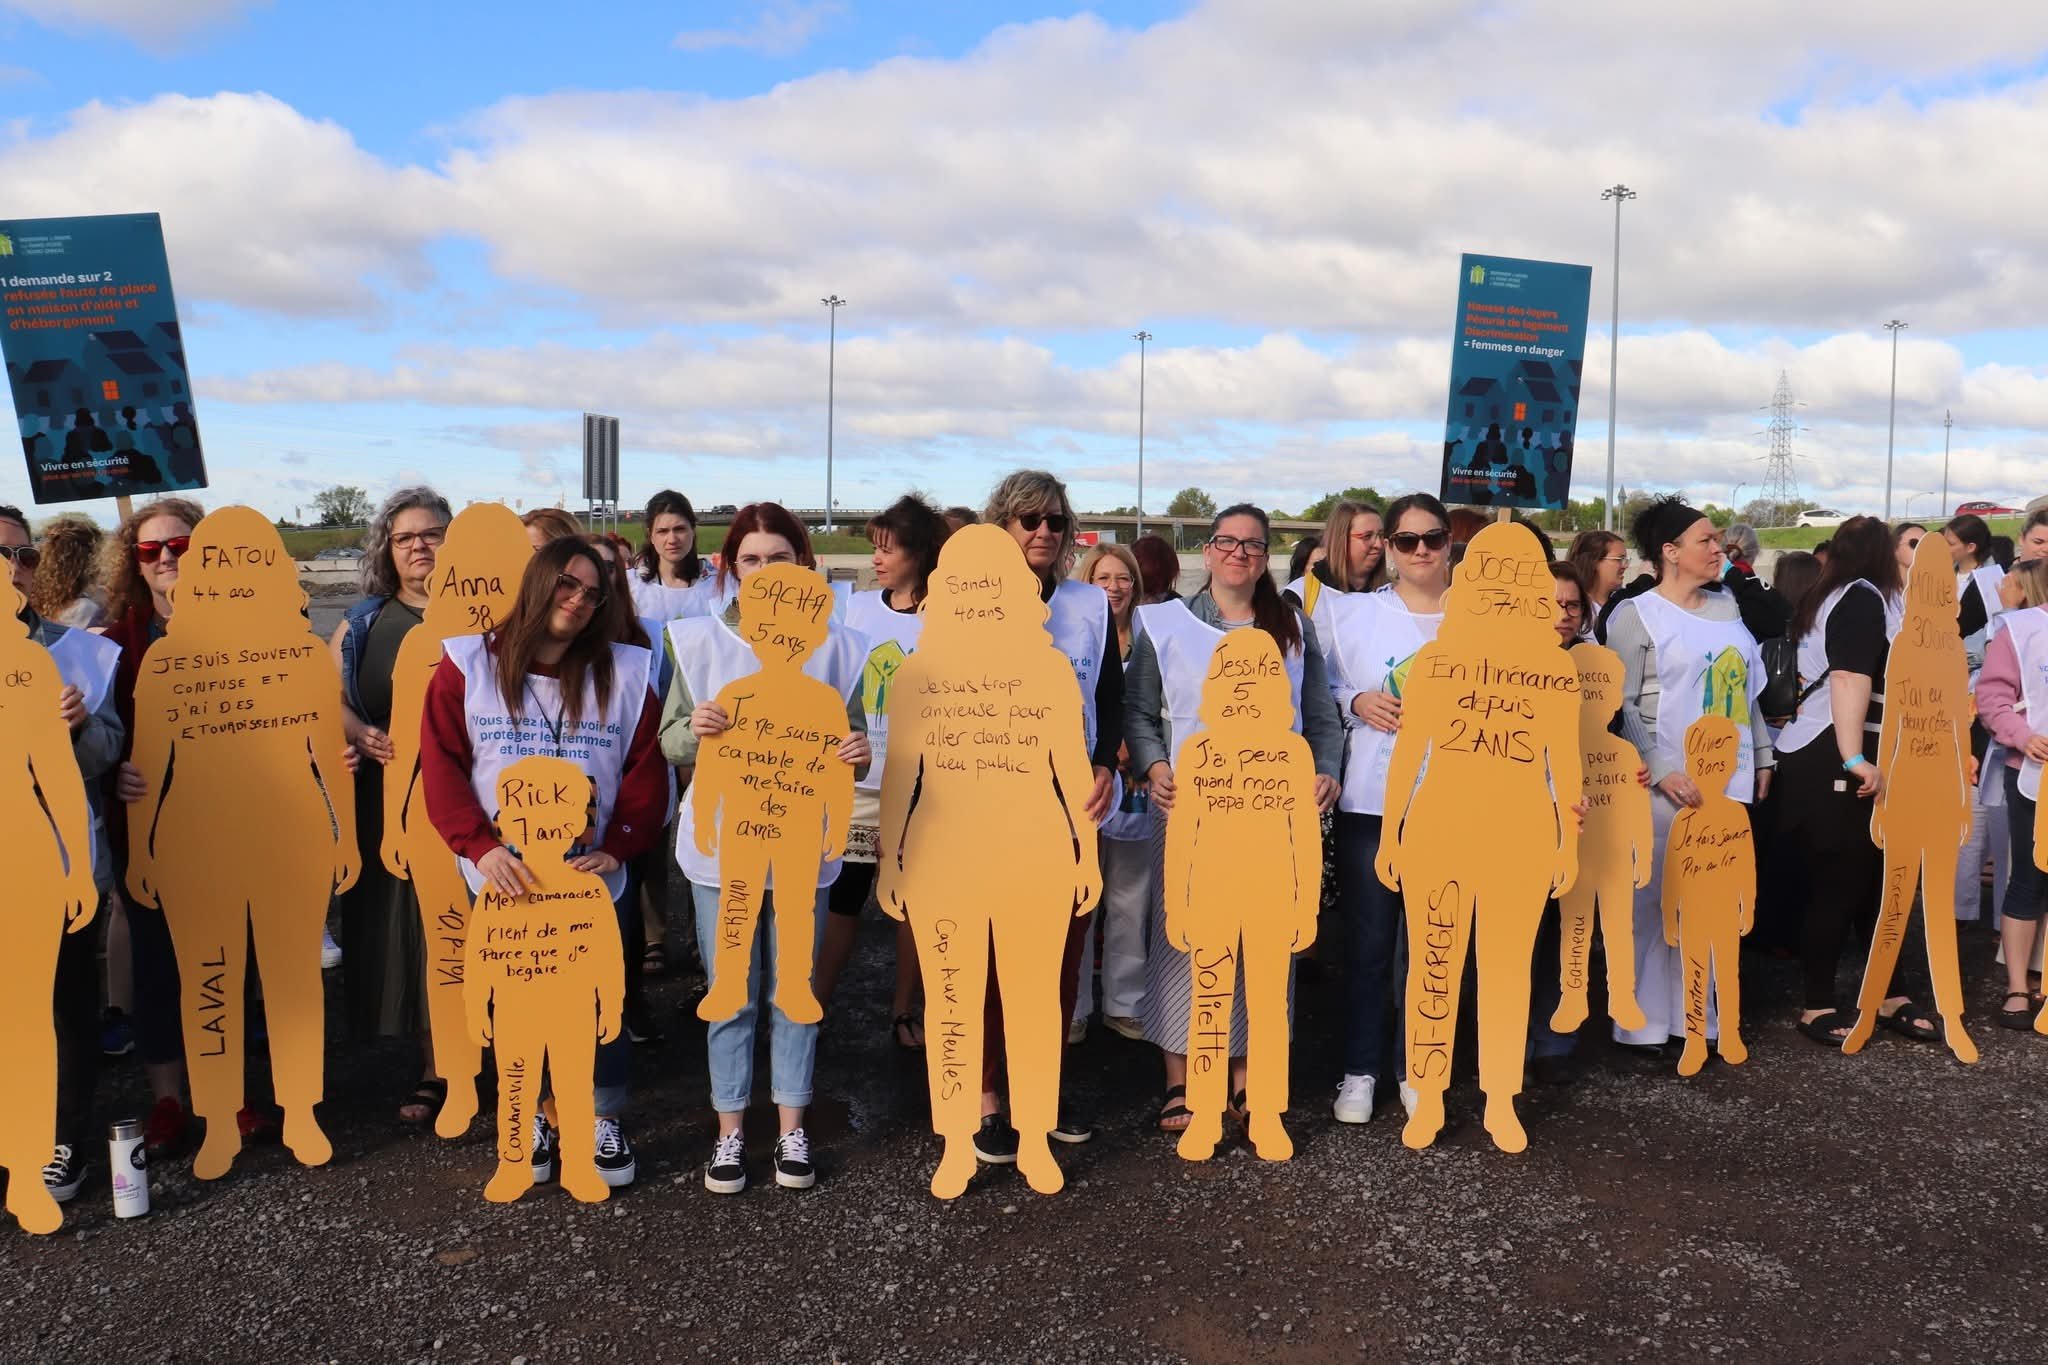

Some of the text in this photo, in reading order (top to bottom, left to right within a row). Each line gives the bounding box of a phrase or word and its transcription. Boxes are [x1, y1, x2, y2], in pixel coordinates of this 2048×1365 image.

[9, 273, 76, 287] demande
[78, 273, 101, 283] sur
[104, 272, 112, 281] 2
[60, 287, 96, 297] faute
[100, 286, 116, 296] de
[121, 283, 157, 296] place
[7, 299, 139, 316] en maison d'aide et
[1507, 306, 1524, 316] des
[1508, 318, 1520, 328] de
[1471, 339, 1513, 352] femmes
[1514, 345, 1527, 353] en
[1529, 345, 1564, 358] danger
[40, 463, 69, 471] Vivre
[86, 456, 129, 468] sécurité
[1452, 467, 1472, 476] Vivre
[1485, 468, 1517, 479] sécurité
[201, 545, 276, 569] FATOU
[194, 586, 220, 599] 44
[439, 566, 504, 597] Anna
[946, 573, 1002, 599] Sandy
[748, 577, 828, 623] SACHA
[467, 604, 494, 631] 38
[750, 623, 807, 662] 5 ans
[237, 646, 314, 663] SOUVENT
[1081, 656, 1091, 666] de
[5, 669, 32, 687] de
[262, 673, 289, 685] ET
[1426, 655, 1466, 681] En
[1577, 669, 1611, 684] becca
[981, 673, 1023, 696] trop
[1233, 681, 1256, 701] 5
[1583, 689, 1604, 700] ans
[219, 699, 254, 714] DES
[920, 702, 1053, 727] anxieuse pour
[1221, 703, 1262, 719] ans
[1458, 690, 1535, 720] depuis
[472, 715, 503, 726] Vous
[540, 718, 551, 728] le
[607, 723, 621, 735] de
[725, 693, 842, 754] Je ne suis pa
[480, 728, 537, 742] protéger
[562, 732, 612, 748] femmes
[925, 725, 1039, 747] aller dans un
[1439, 718, 1535, 764] 2 ANS
[500, 744, 512, 755] et
[516, 744, 535, 756] les
[718, 745, 825, 773] capable de
[1194, 738, 1226, 769] J'ai
[1587, 751, 1618, 768] peur
[935, 751, 1031, 781] lieu public
[1193, 773, 1289, 797] quand mon
[1596, 773, 1627, 785] faire
[760, 793, 787, 818] des
[1206, 795, 1245, 814] papa
[513, 817, 576, 846] 7 ans
[736, 820, 782, 839] amis
[1675, 811, 1696, 850] Je
[484, 888, 601, 911] Mes camarades
[721, 880, 750, 950] VERDUN
[536, 922, 558, 938] de
[569, 917, 594, 933] moi
[437, 904, 465, 986] Val-d'Or
[478, 944, 589, 965] Parce que je
[1567, 915, 1586, 989] Gatineau
[1412, 880, 1460, 1079] ST-GEORGES
[198, 946, 226, 1057] LAVAL
[1194, 945, 1234, 1075] Joliette
[503, 1056, 525, 1164] Cowansville
